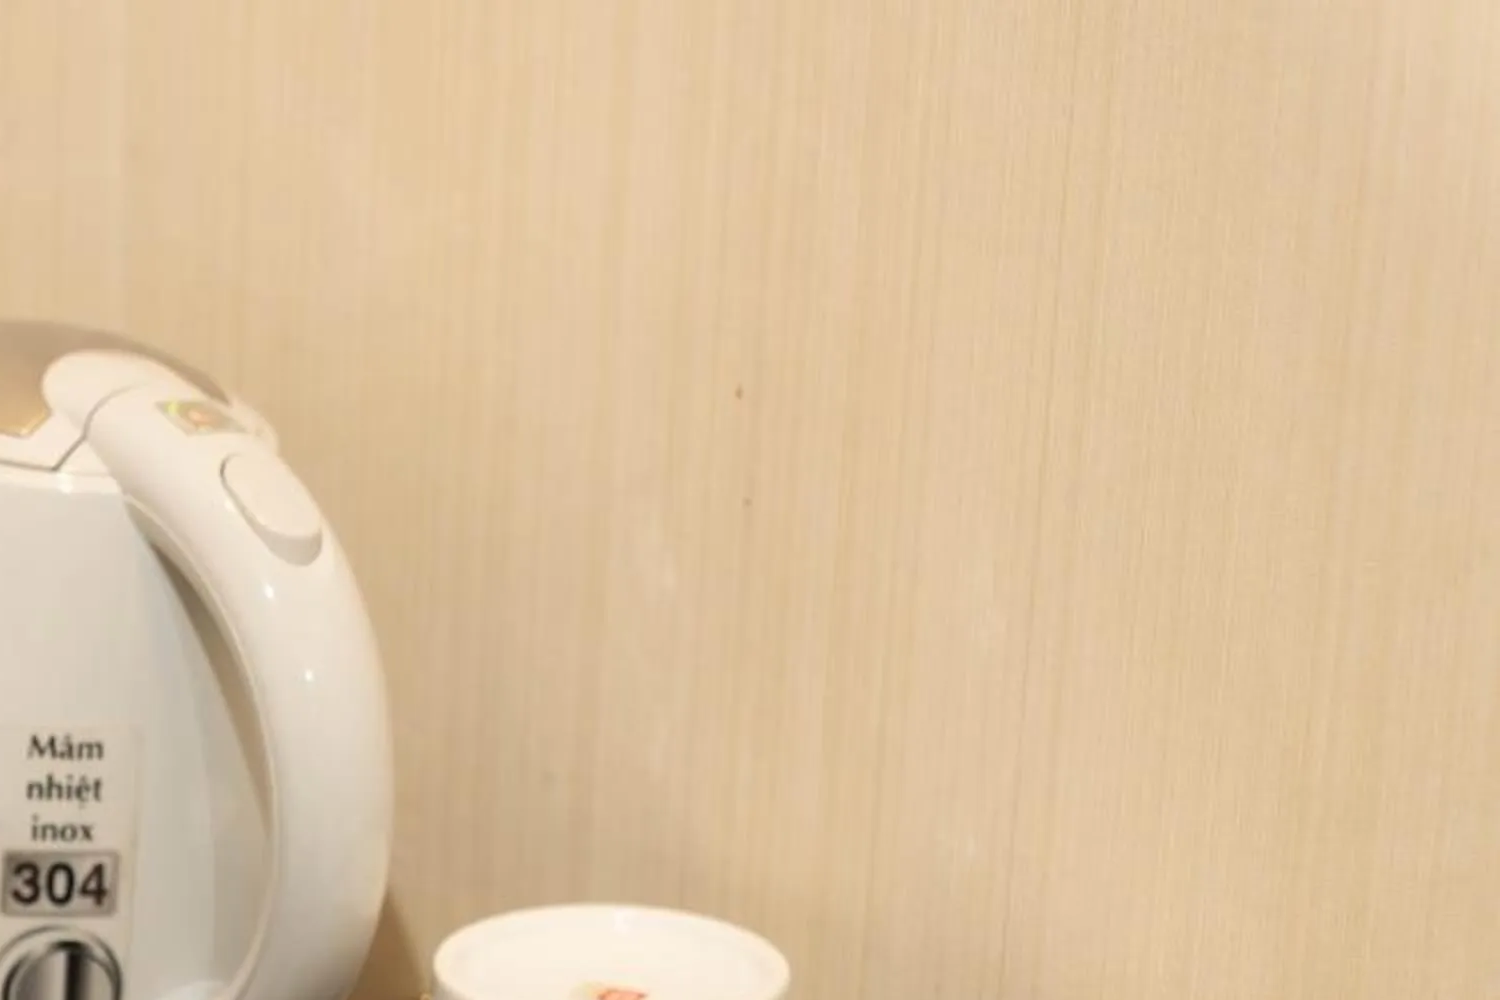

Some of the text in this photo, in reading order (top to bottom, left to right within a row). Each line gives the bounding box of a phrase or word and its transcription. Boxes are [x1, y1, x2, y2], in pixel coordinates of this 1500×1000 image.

[26, 772, 102, 810] nhiệt
[30, 812, 95, 842] inox
[12, 860, 108, 907] 304
